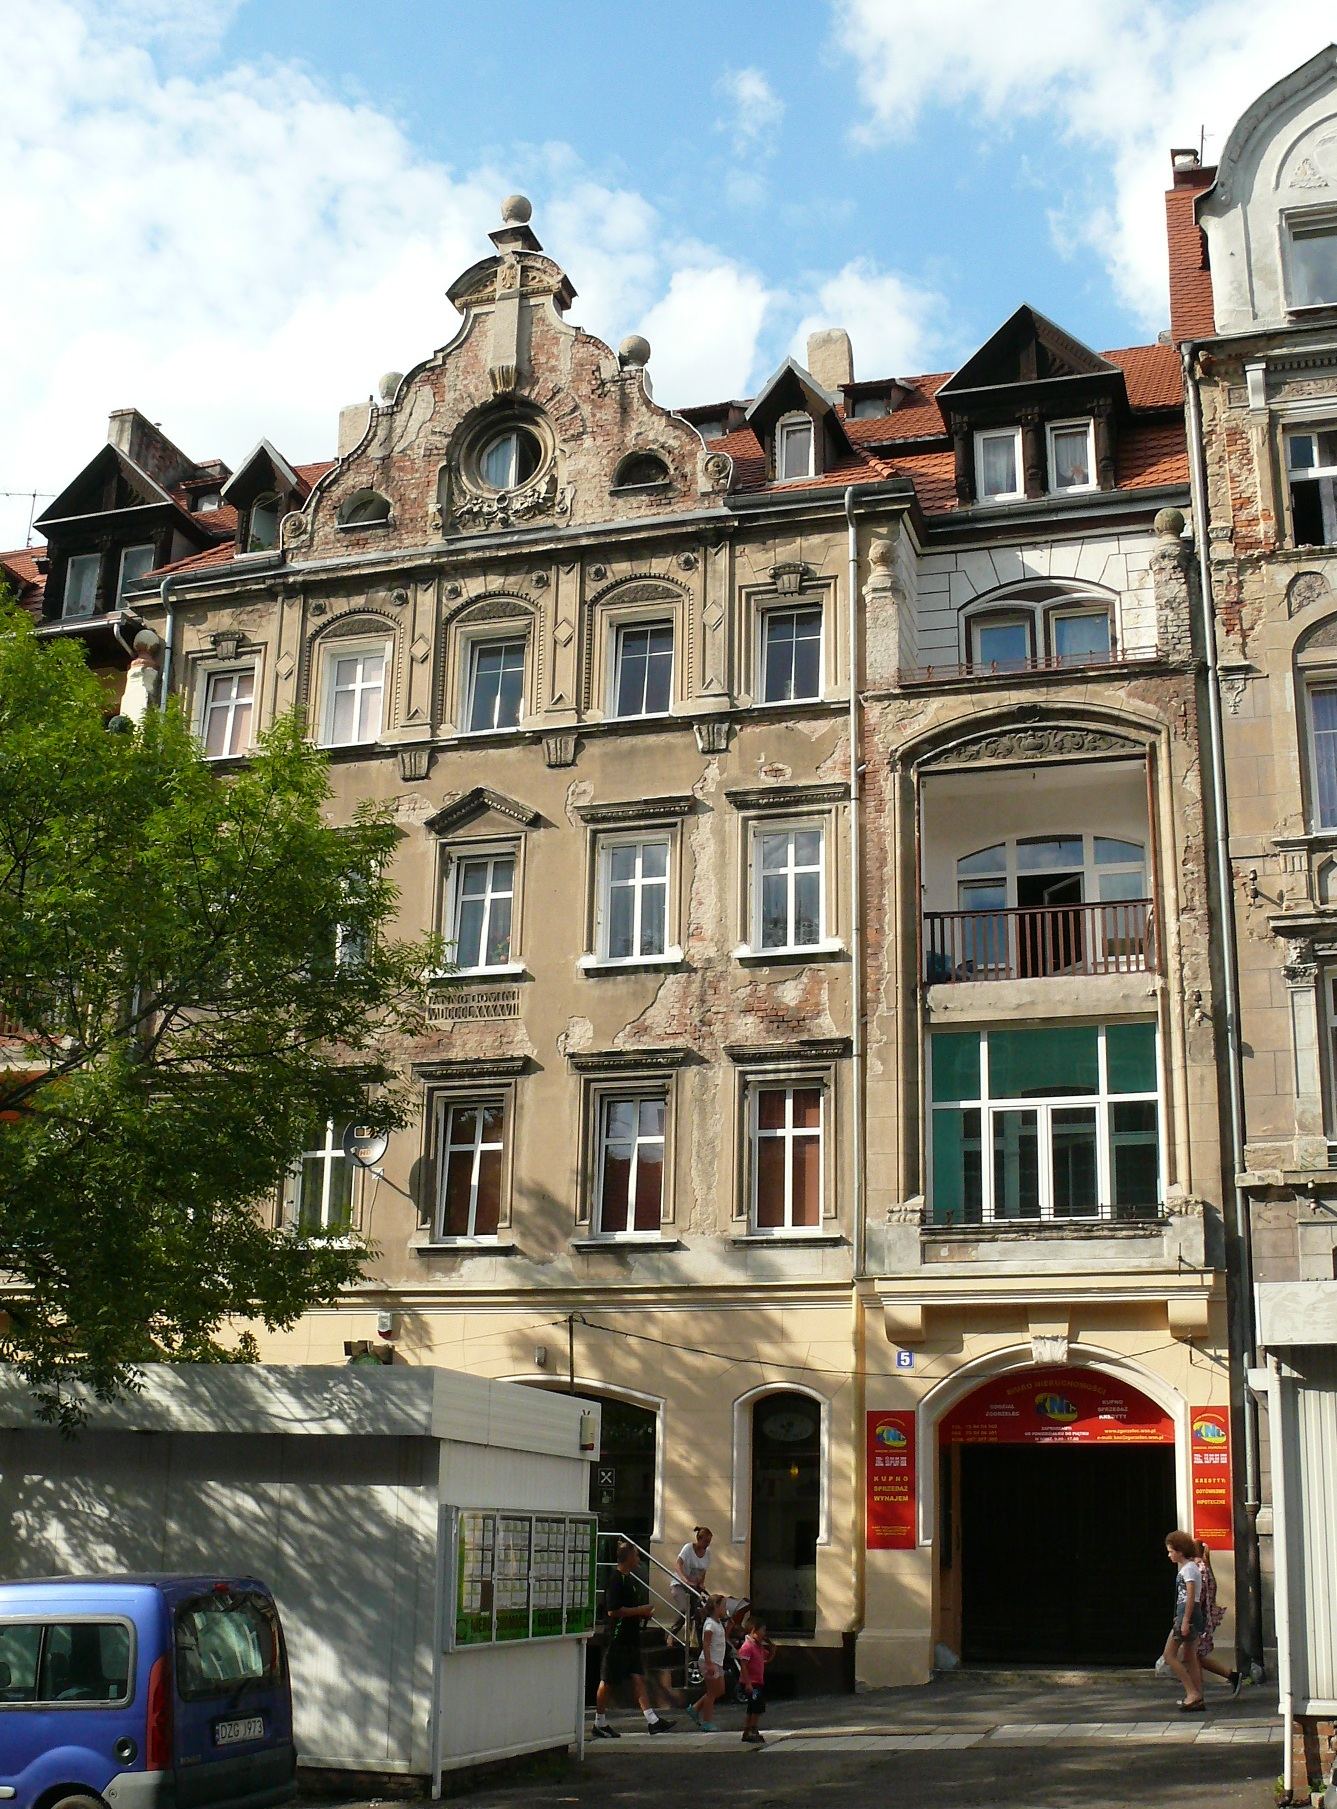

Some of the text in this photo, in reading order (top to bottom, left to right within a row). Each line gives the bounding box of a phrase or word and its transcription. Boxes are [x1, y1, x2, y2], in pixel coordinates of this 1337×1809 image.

[470, 988, 519, 1003] DOMINI
[900, 1352, 910, 1366] 5
[1006, 1383, 1033, 1396] BIURO
[220, 1723, 240, 1739] DZG
